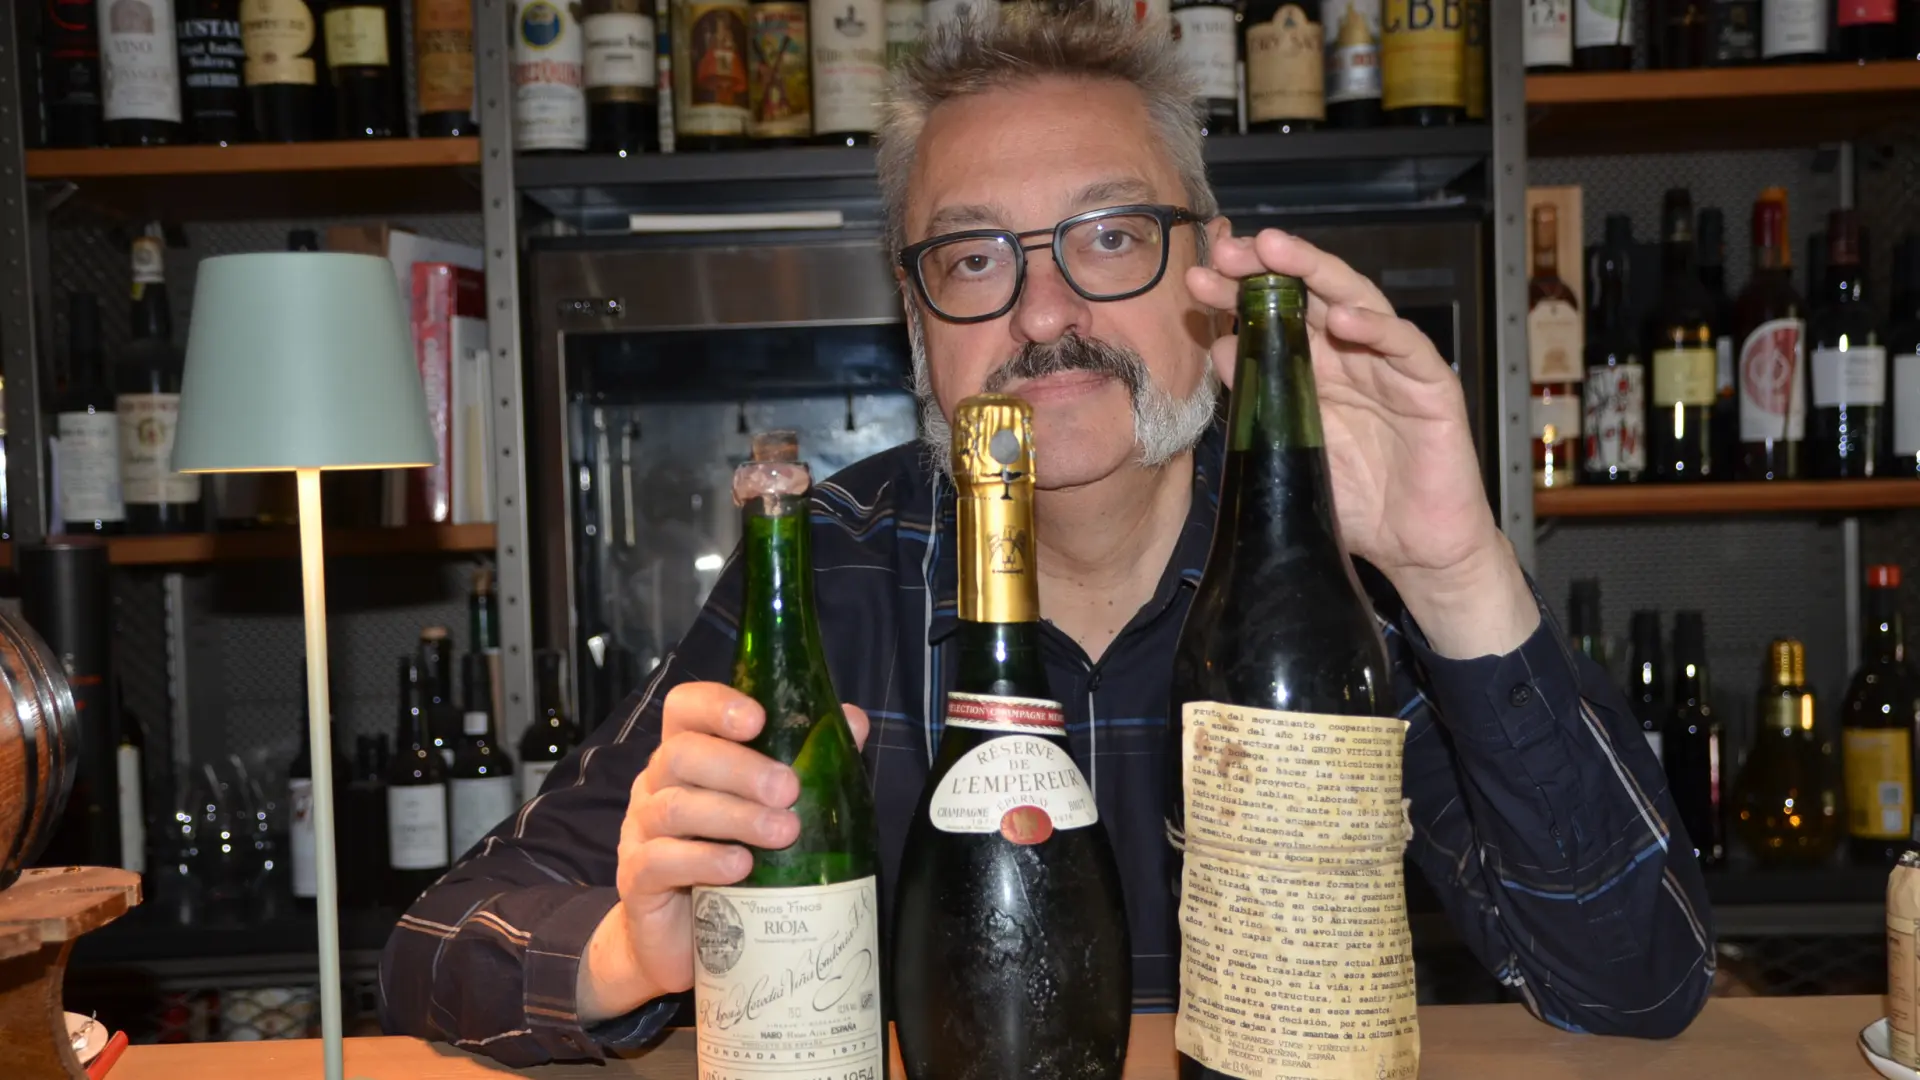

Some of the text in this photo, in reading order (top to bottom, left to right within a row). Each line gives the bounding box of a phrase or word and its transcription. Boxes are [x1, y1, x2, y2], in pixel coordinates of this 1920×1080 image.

[1227, 713, 1244, 721] del
[1247, 727, 1265, 736] del
[1303, 732, 1328, 741] 1967
[1237, 739, 1280, 750] rectora
[1286, 743, 1305, 752] del
[1311, 746, 1342, 755] GRUPO
[1009, 758, 1031, 771] DE
[1295, 758, 1320, 766] unen
[951, 768, 1081, 795] L'EMPEREUR
[1276, 767, 1308, 777] hacer
[1316, 770, 1333, 779] las
[1216, 783, 1244, 794] ellos
[1232, 773, 1249, 783] del
[1317, 783, 1341, 792] para
[936, 806, 990, 819] CHAMPAGNE
[1220, 806, 1236, 817] los
[1285, 818, 1341, 828] encuentra
[1286, 804, 1330, 815] durante
[1336, 807, 1352, 817] los
[1242, 823, 1330, 840] almacenada en
[1203, 873, 1212, 882] la
[1218, 878, 1250, 891] tirada
[1260, 887, 1279, 896] que
[1222, 915, 1233, 924] el
[1239, 918, 1263, 929] vino
[1271, 912, 1284, 921] de
[1312, 916, 1324, 924] 50
[764, 919, 809, 935] RIOJA
[1281, 937, 1294, 946] de
[1346, 941, 1372, 950] parte
[1215, 943, 1375, 967] el origen de nuestro actual
[1227, 958, 1257, 970] puede
[1266, 965, 1322, 979] trasladar
[1240, 972, 1283, 988] trabajo
[1308, 981, 1320, 990] la
[1244, 986, 1257, 994] su
[1265, 990, 1332, 1003] estructura,
[1341, 995, 1351, 1003] al
[1199, 996, 1247, 1016] celebramos
[1253, 1012, 1276, 1021] esa
[1340, 1020, 1355, 1029] por
[1361, 1019, 1370, 1027] el
[1224, 994, 1264, 1007] nuestra
[1271, 1002, 1303, 1013] gente
[1309, 1007, 1321, 1015] en
[760, 1031, 783, 1040] HARO
[831, 1022, 857, 1035] ESPAÑA
[1222, 1016, 1236, 1025] nos
[1240, 1021, 1266, 1032] dejan
[1281, 1027, 1298, 1036] los
[1302, 1029, 1339, 1039] amantes
[1357, 1030, 1365, 1039] la
[1241, 1033, 1275, 1045] GRANDES
[1308, 1043, 1313, 1051] Y
[706, 1041, 867, 1061] FUNDADA EN 1877
